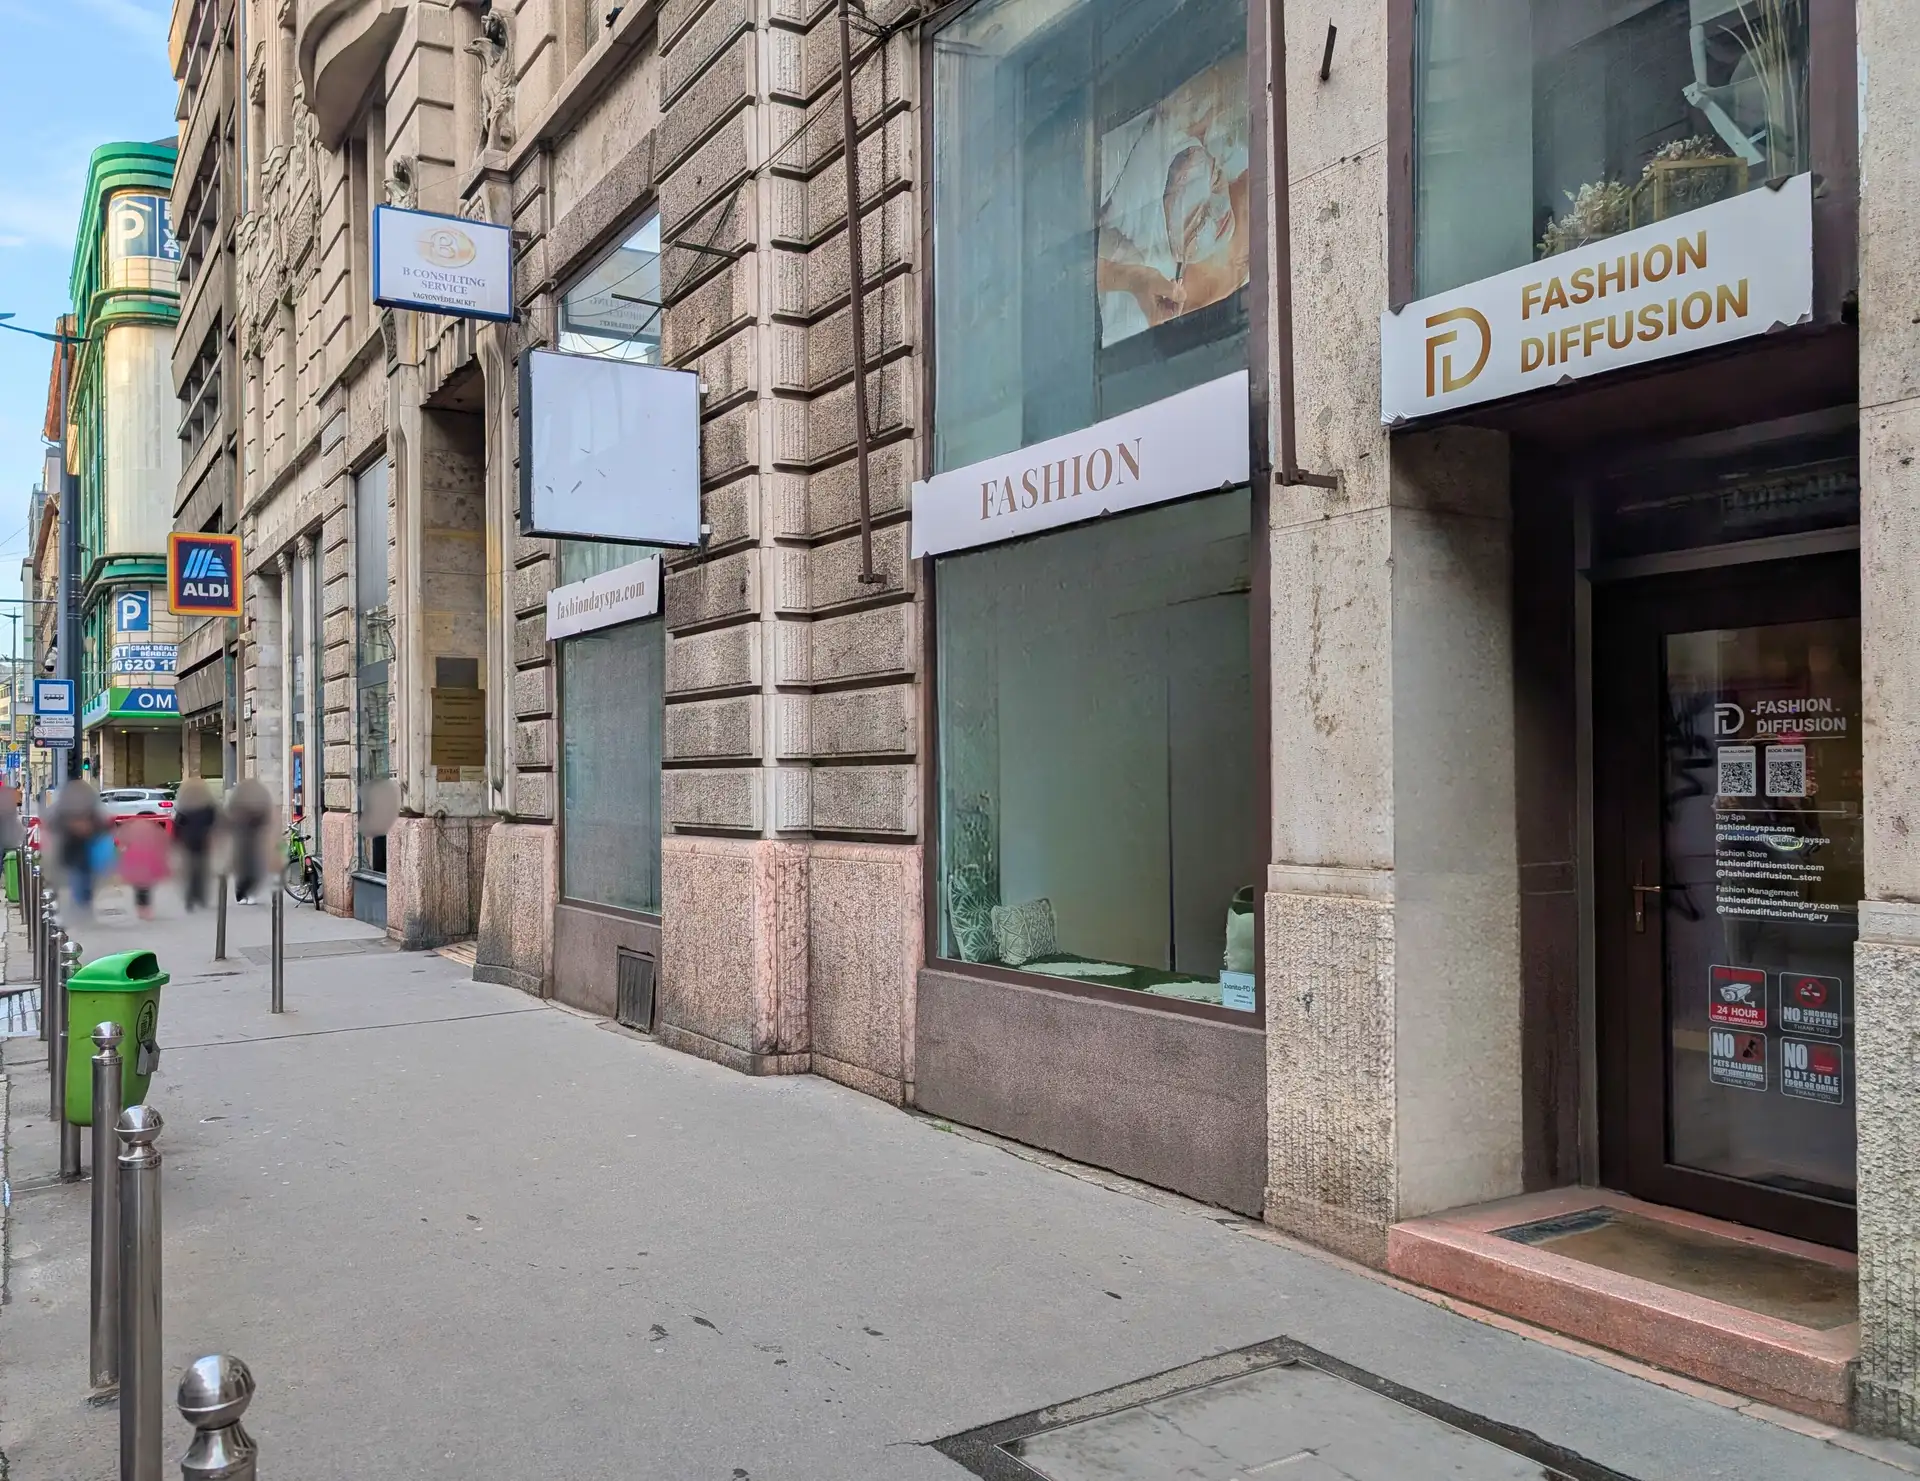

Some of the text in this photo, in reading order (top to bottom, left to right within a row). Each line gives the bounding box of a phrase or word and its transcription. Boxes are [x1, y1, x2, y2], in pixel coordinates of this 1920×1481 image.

[402, 266, 486, 288] B CONSULTING
[1522, 230, 1707, 320] FASHION
[421, 280, 468, 295] SERVICE
[1521, 279, 1748, 373] DIFFUSION
[980, 437, 1142, 521] FASHION
[182, 582, 230, 598] ALDI
[556, 581, 646, 621] fashiondayspa.com
[122, 600, 142, 630] P
[124, 660, 156, 671] 620
[138, 693, 179, 709] OM
[1756, 698, 1833, 716] FASHION
[1756, 717, 1847, 733] DIFFUSION
[1715, 813, 1746, 822] Day Spa
[1715, 823, 1795, 833] fashiondayspa.com
[1715, 849, 1768, 859] Fashion Store
[1715, 859, 1825, 872] fashiondiffusionstore.com
[1716, 869, 1822, 882] @fashiondiffusion_store
[1715, 885, 1800, 898] Fashion Management
[1715, 895, 1840, 911] fashiondiffusionhungary.com
[1716, 905, 1829, 921] @fashiondiffusionhungary
[1717, 1005, 1758, 1019] 24 HOUR
[1783, 1006, 1800, 1021] NO
[1803, 1009, 1838, 1019] SMOKING
[1728, 1016, 1764, 1026] SURVEILLANCE
[1793, 1023, 1830, 1034] THANK YOU
[1803, 1015, 1838, 1027] VAPING
[1712, 1032, 1735, 1059] NO
[1784, 1042, 1808, 1070] NO
[1713, 1058, 1763, 1073] PETS ALLOWED
[1722, 1076, 1757, 1087] THANK YOU
[1784, 1069, 1839, 1086] OUTSIDE
[1785, 1078, 1839, 1094] FOOD OR DRINK
[1795, 1088, 1816, 1098] THANK
